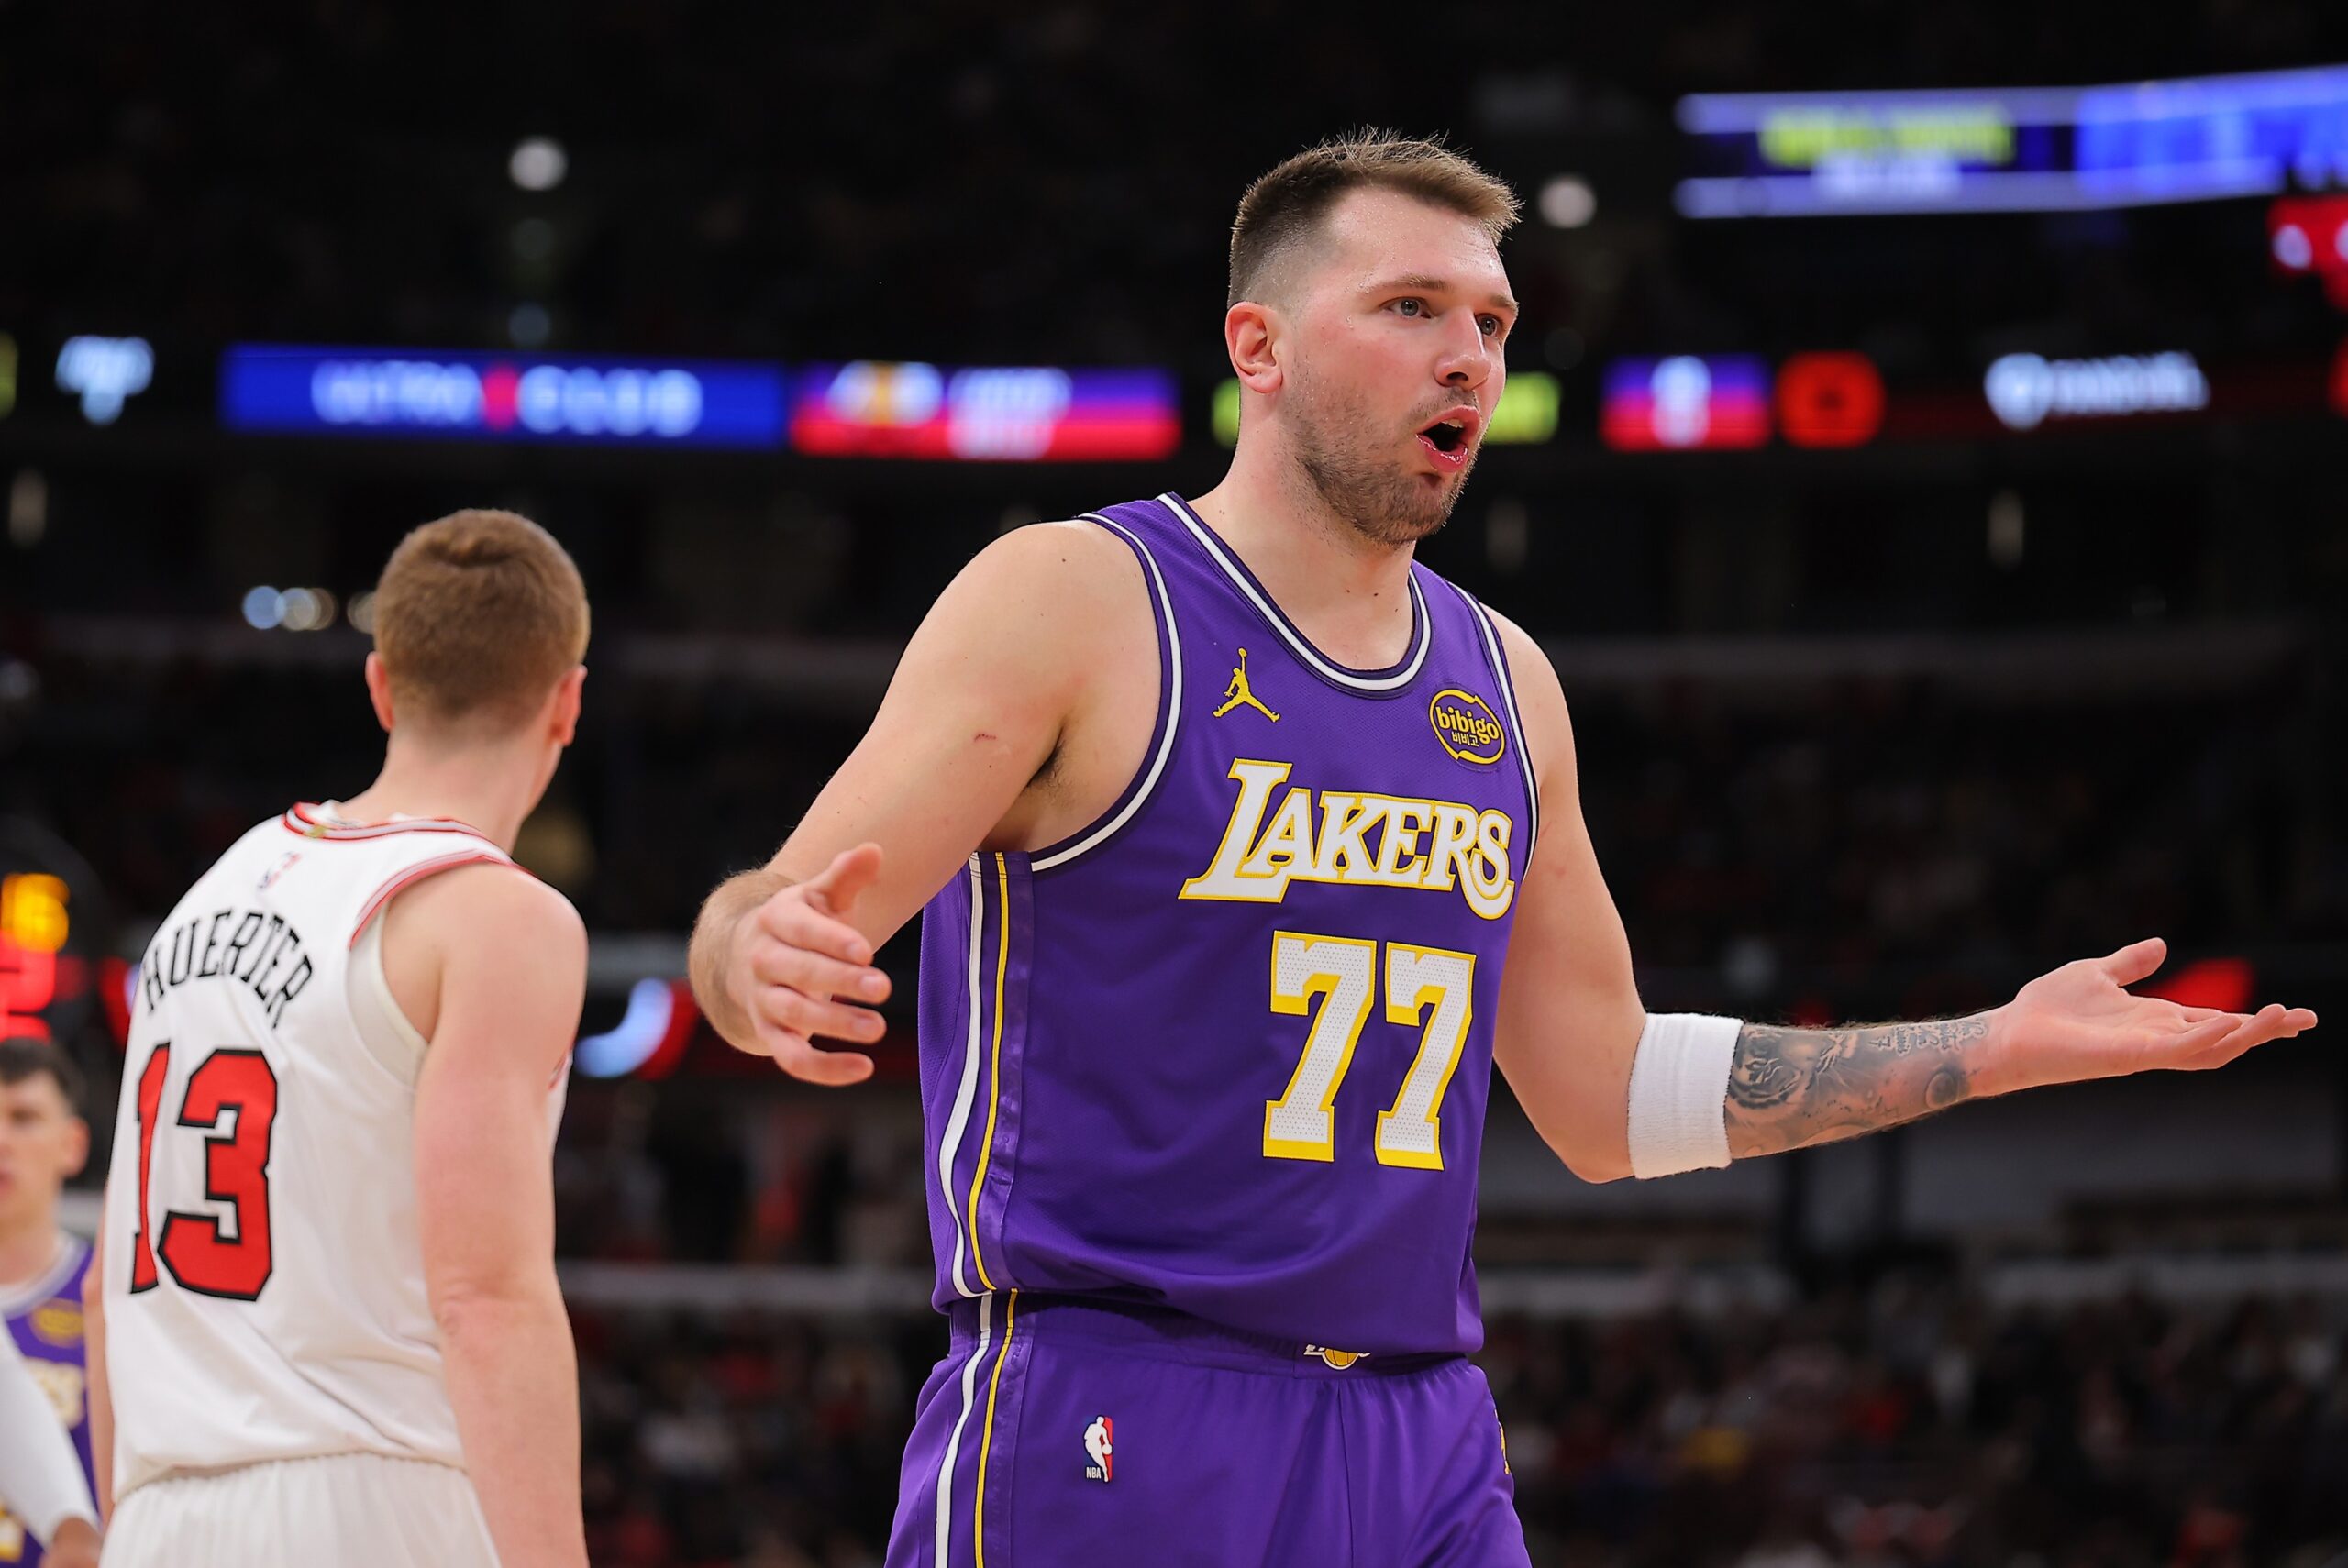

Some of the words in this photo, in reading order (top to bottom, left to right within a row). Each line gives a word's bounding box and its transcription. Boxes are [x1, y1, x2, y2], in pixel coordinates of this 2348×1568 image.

[1435, 706, 1500, 745] bibigo
[1451, 731, 1479, 747] 비비고
[142, 906, 313, 1029] HUERTER
[1262, 929, 1478, 1172] 77
[129, 1041, 279, 1302] 13
[1086, 1466, 1102, 1479] NBA
